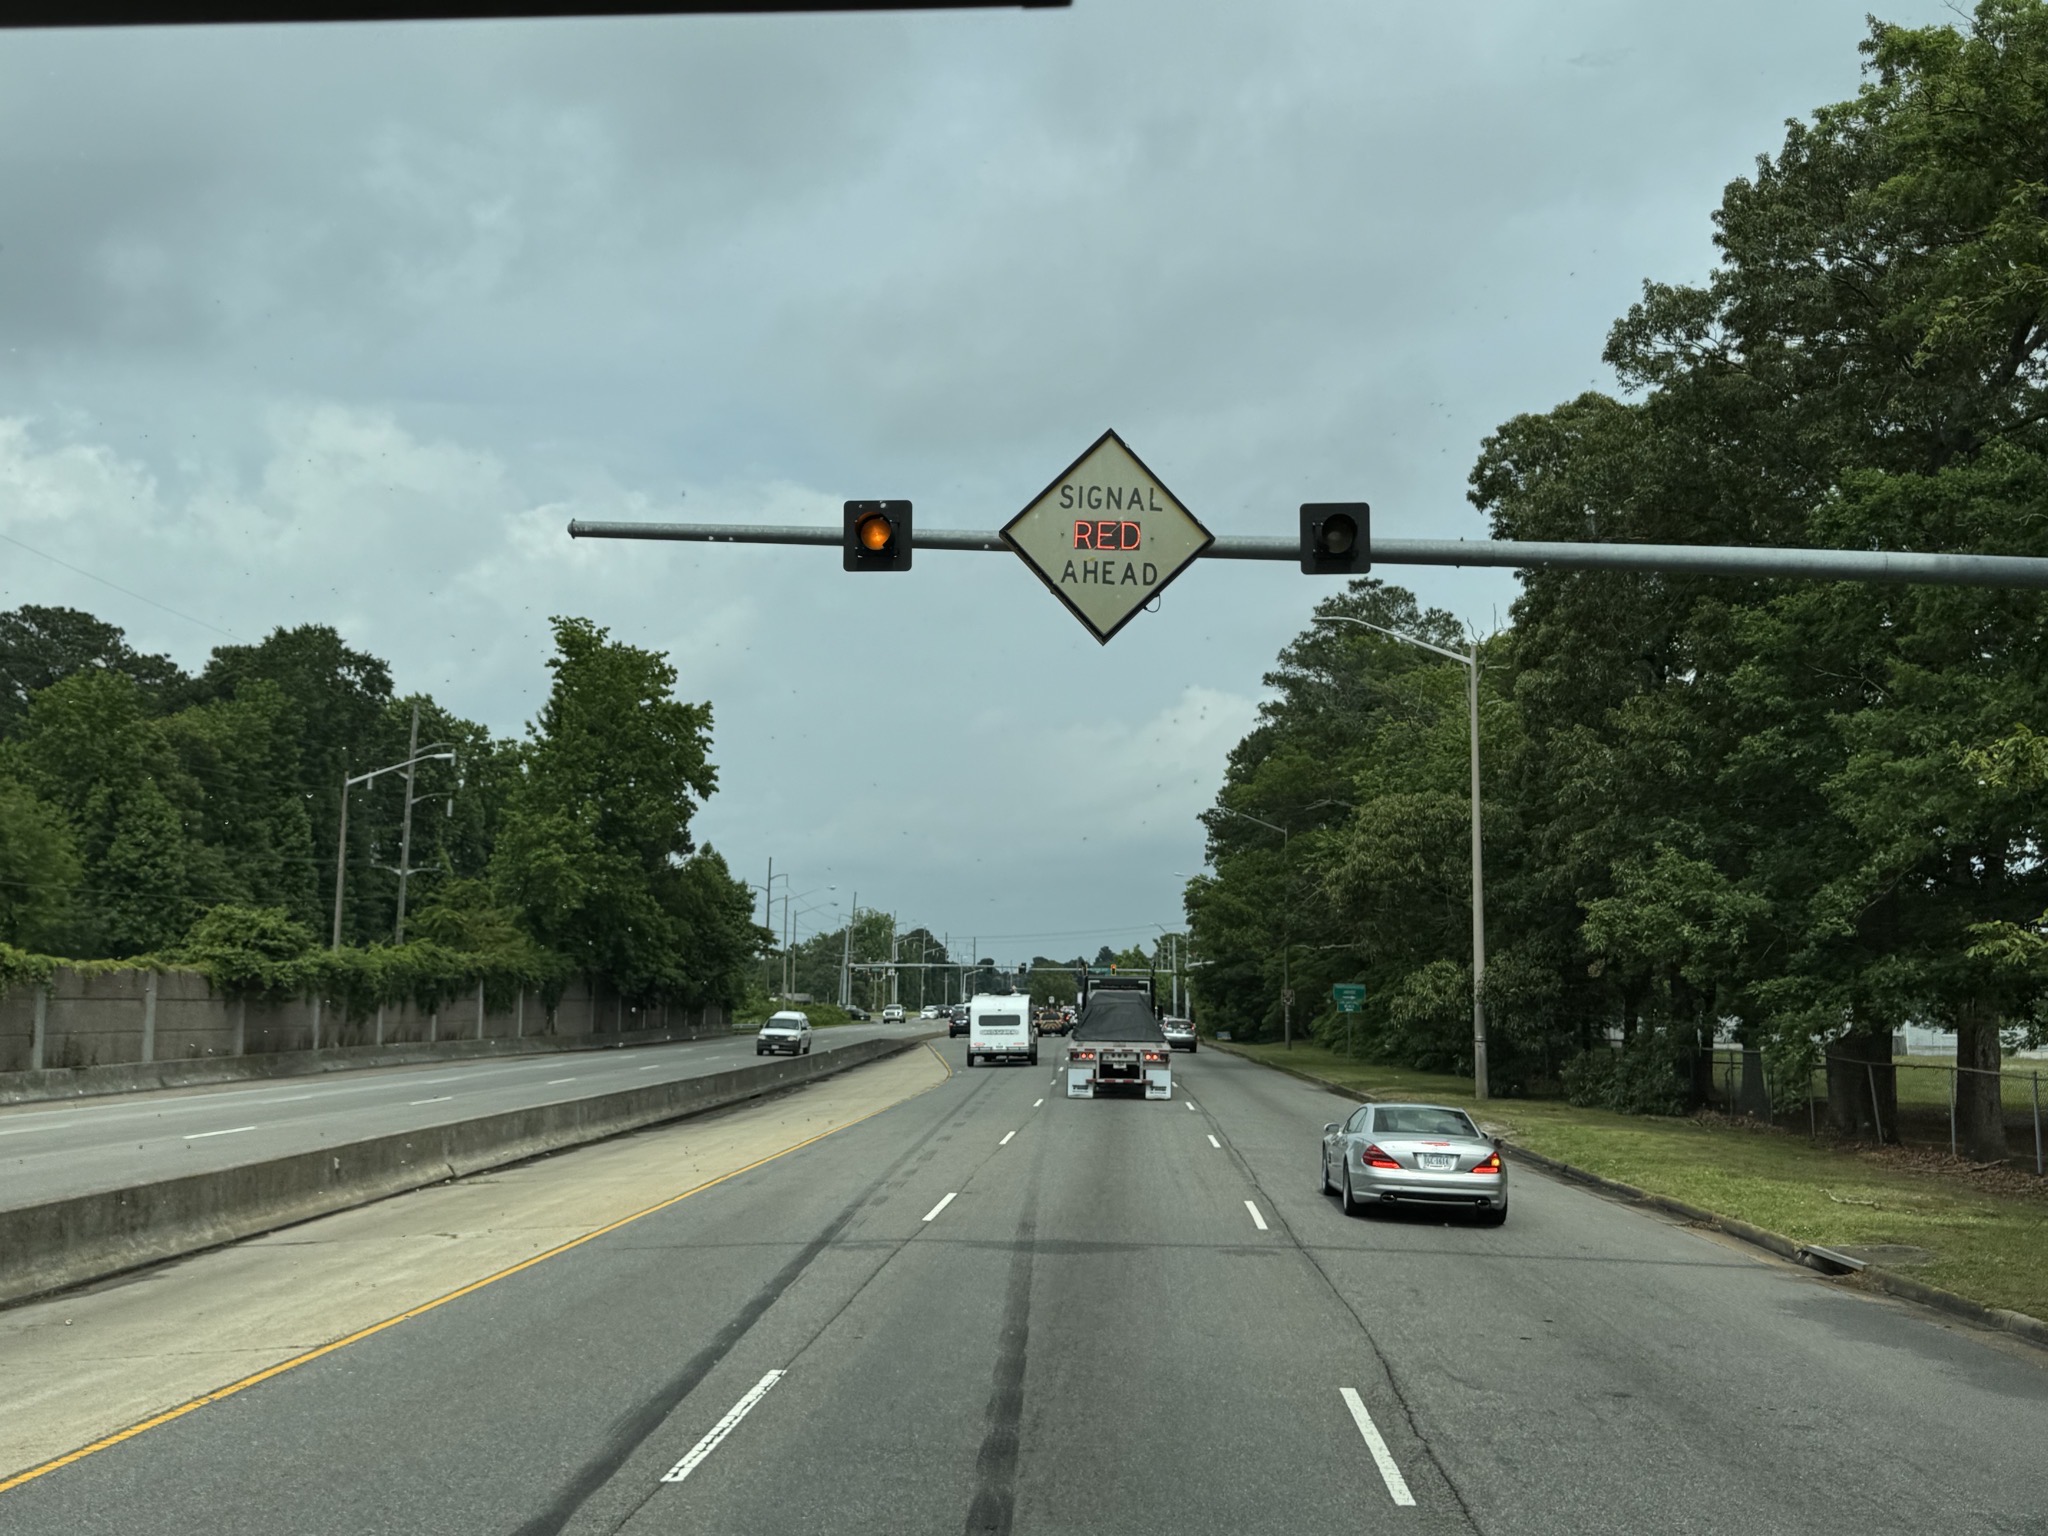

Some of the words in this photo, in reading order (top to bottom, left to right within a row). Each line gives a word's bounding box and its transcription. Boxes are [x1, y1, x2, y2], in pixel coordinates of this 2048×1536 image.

[1059, 484, 1162, 512] SIGNAL
[1073, 520, 1141, 550] RED
[1060, 560, 1157, 586] AHEAD
